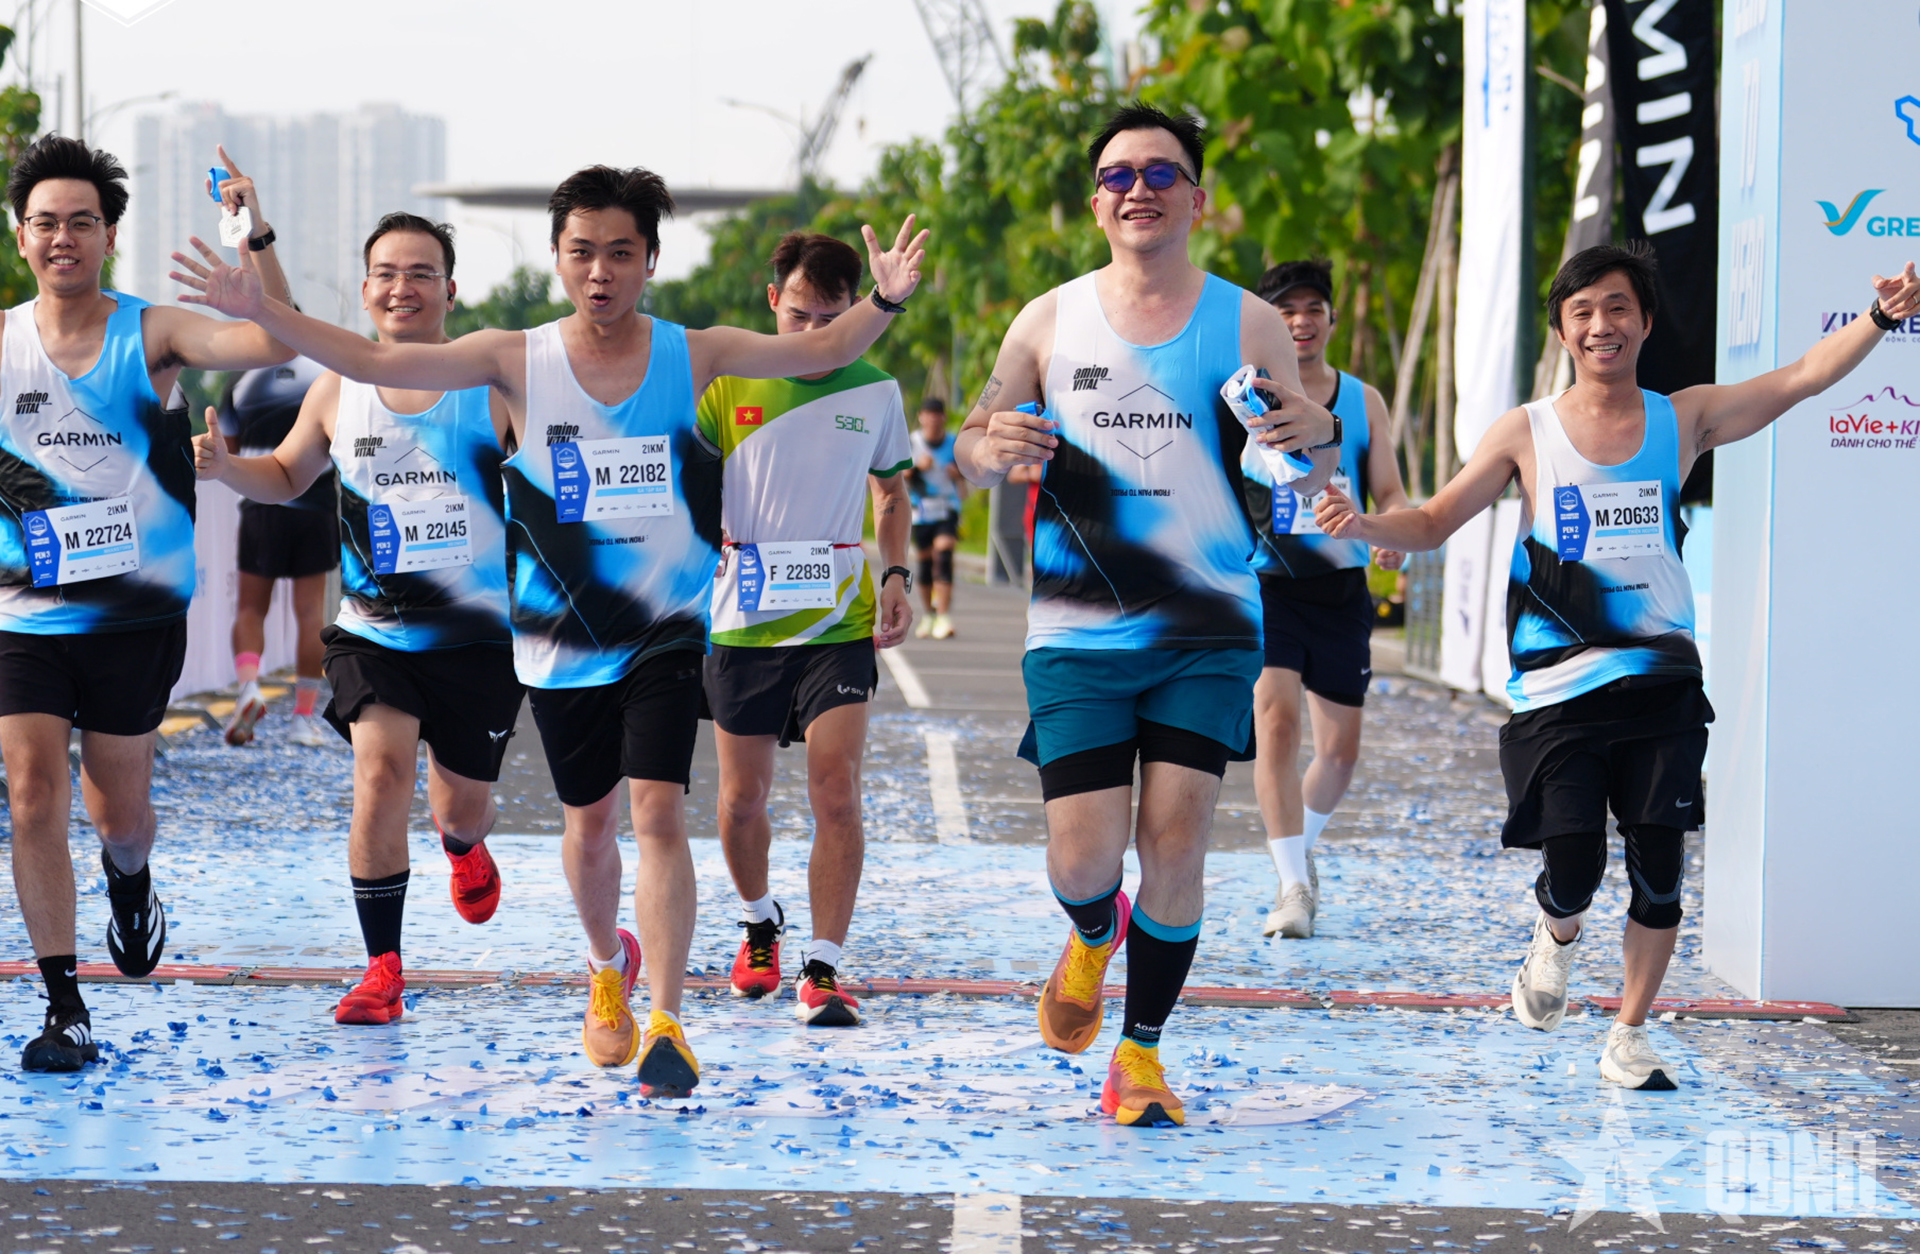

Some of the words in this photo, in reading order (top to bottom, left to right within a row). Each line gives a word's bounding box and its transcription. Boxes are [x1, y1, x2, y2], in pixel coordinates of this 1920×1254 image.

[1728, 214, 1766, 347] HERO
[1073, 364, 1109, 380] amino
[1072, 379, 1099, 391] VITAL
[15, 389, 49, 404] amino
[15, 402, 40, 415] VITAL
[1093, 411, 1193, 430] GARMIN
[546, 421, 580, 436] amino
[37, 431, 123, 447] GARMIN
[354, 434, 384, 448] amino
[1831, 436, 1864, 448] DÀNH
[1866, 438, 1892, 449] CHO
[1895, 436, 1918, 449] THẾ
[354, 446, 377, 458] VITAL
[592, 448, 620, 456] GARMIN
[641, 443, 664, 455] 21KM
[375, 470, 457, 487] GARMIN
[595, 466, 611, 486] M
[619, 462, 667, 485] 22182
[561, 486, 573, 494] PEN
[573, 485, 579, 493] 3
[1638, 487, 1658, 498] 21KM
[106, 503, 128, 516] 21KM
[445, 503, 464, 513] 21KM
[1302, 497, 1312, 510] M
[60, 513, 86, 522] GARMIN
[1595, 509, 1609, 527] M
[1613, 505, 1659, 526] 20633
[405, 525, 418, 542] M
[426, 520, 467, 540] 22145
[1574, 525, 1579, 533] 2
[65, 531, 80, 550] M
[85, 522, 133, 547] 22724
[810, 547, 829, 556] 21KM
[770, 565, 777, 581] F
[786, 563, 830, 581] 22839
